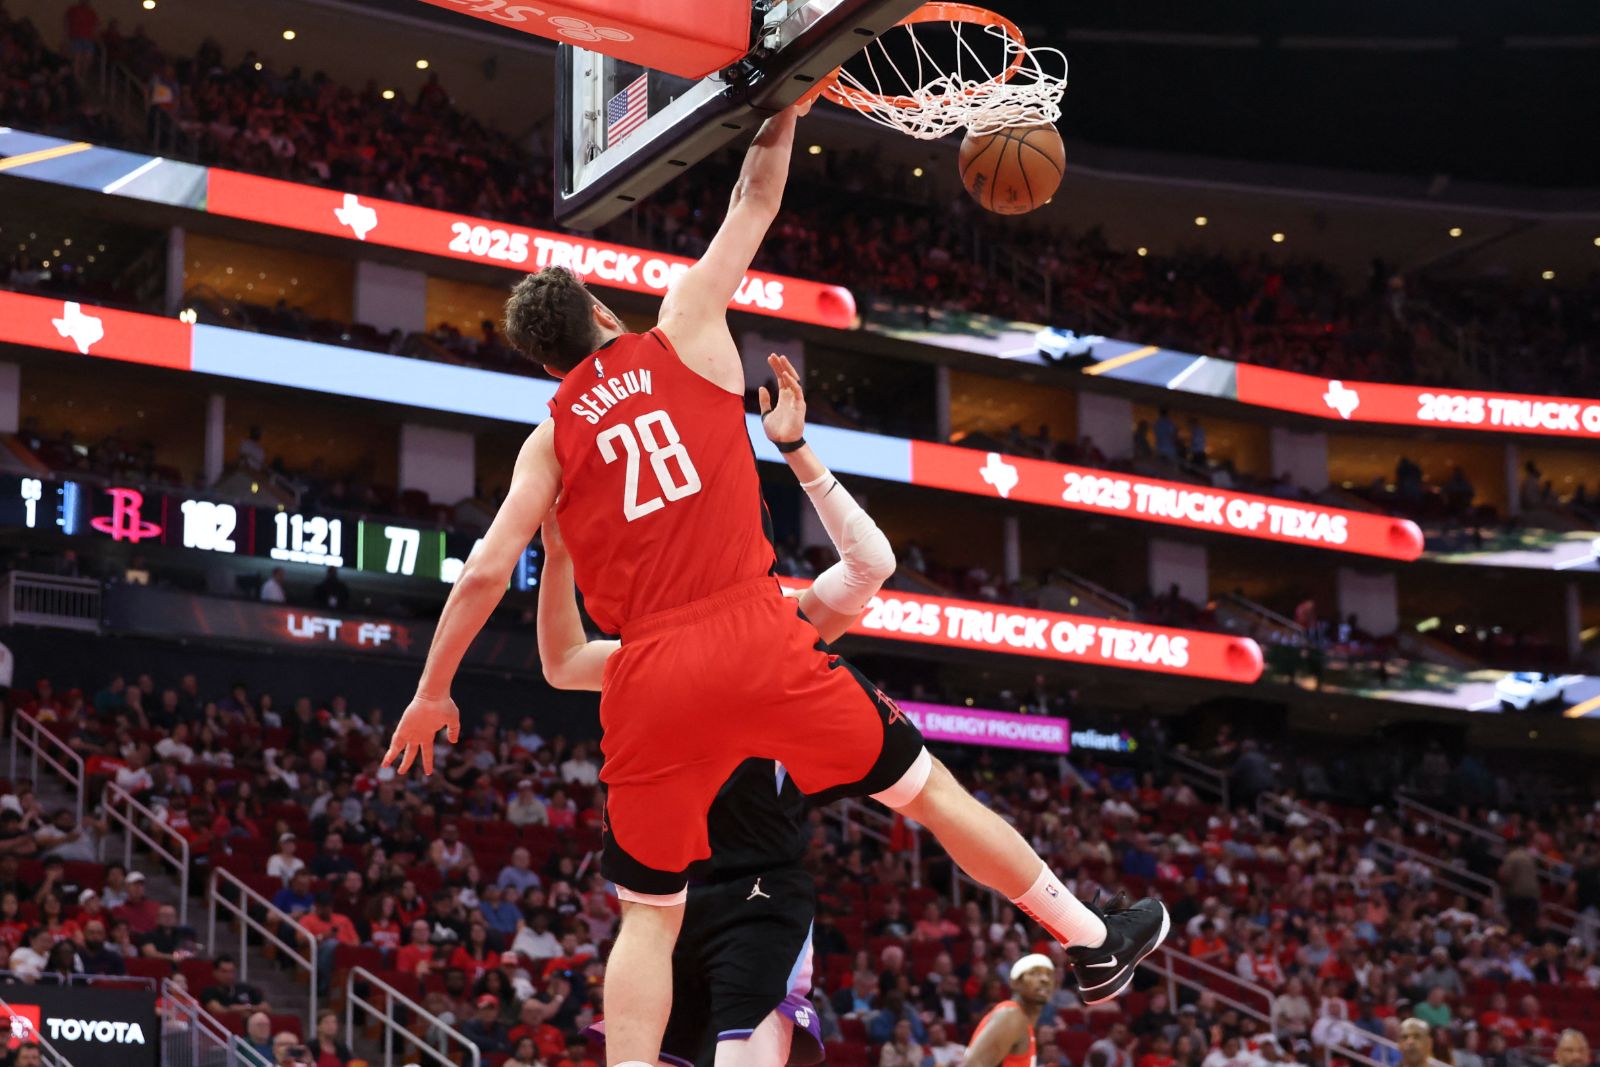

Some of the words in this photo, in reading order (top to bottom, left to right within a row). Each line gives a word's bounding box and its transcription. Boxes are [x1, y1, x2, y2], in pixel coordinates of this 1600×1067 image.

[449, 222, 529, 263] 2025
[534, 237, 641, 284] TRUCK
[730, 276, 784, 310] XAS
[571, 368, 653, 425] SENGUN
[1417, 393, 1485, 424] 2025
[1487, 398, 1581, 431] TRUCK
[1581, 405, 1600, 432] O
[596, 409, 702, 523] 28
[1062, 472, 1130, 510] 2025
[1133, 483, 1225, 525] TRUCK
[1226, 499, 1266, 530] OF
[1267, 505, 1348, 544] TEXAS
[274, 512, 342, 556] 11:21
[384, 526, 420, 576] 77
[287, 614, 342, 641] LIFT
[862, 596, 940, 636] 2025
[944, 606, 1049, 650] TRUCK
[1051, 621, 1096, 655] OF
[1098, 627, 1189, 668] TEXAS
[926, 713, 987, 737] ENERGY
[988, 719, 1063, 743] PROVIDER
[1071, 728, 1121, 751] reliant
[46, 1018, 146, 1044] TOYOTA
